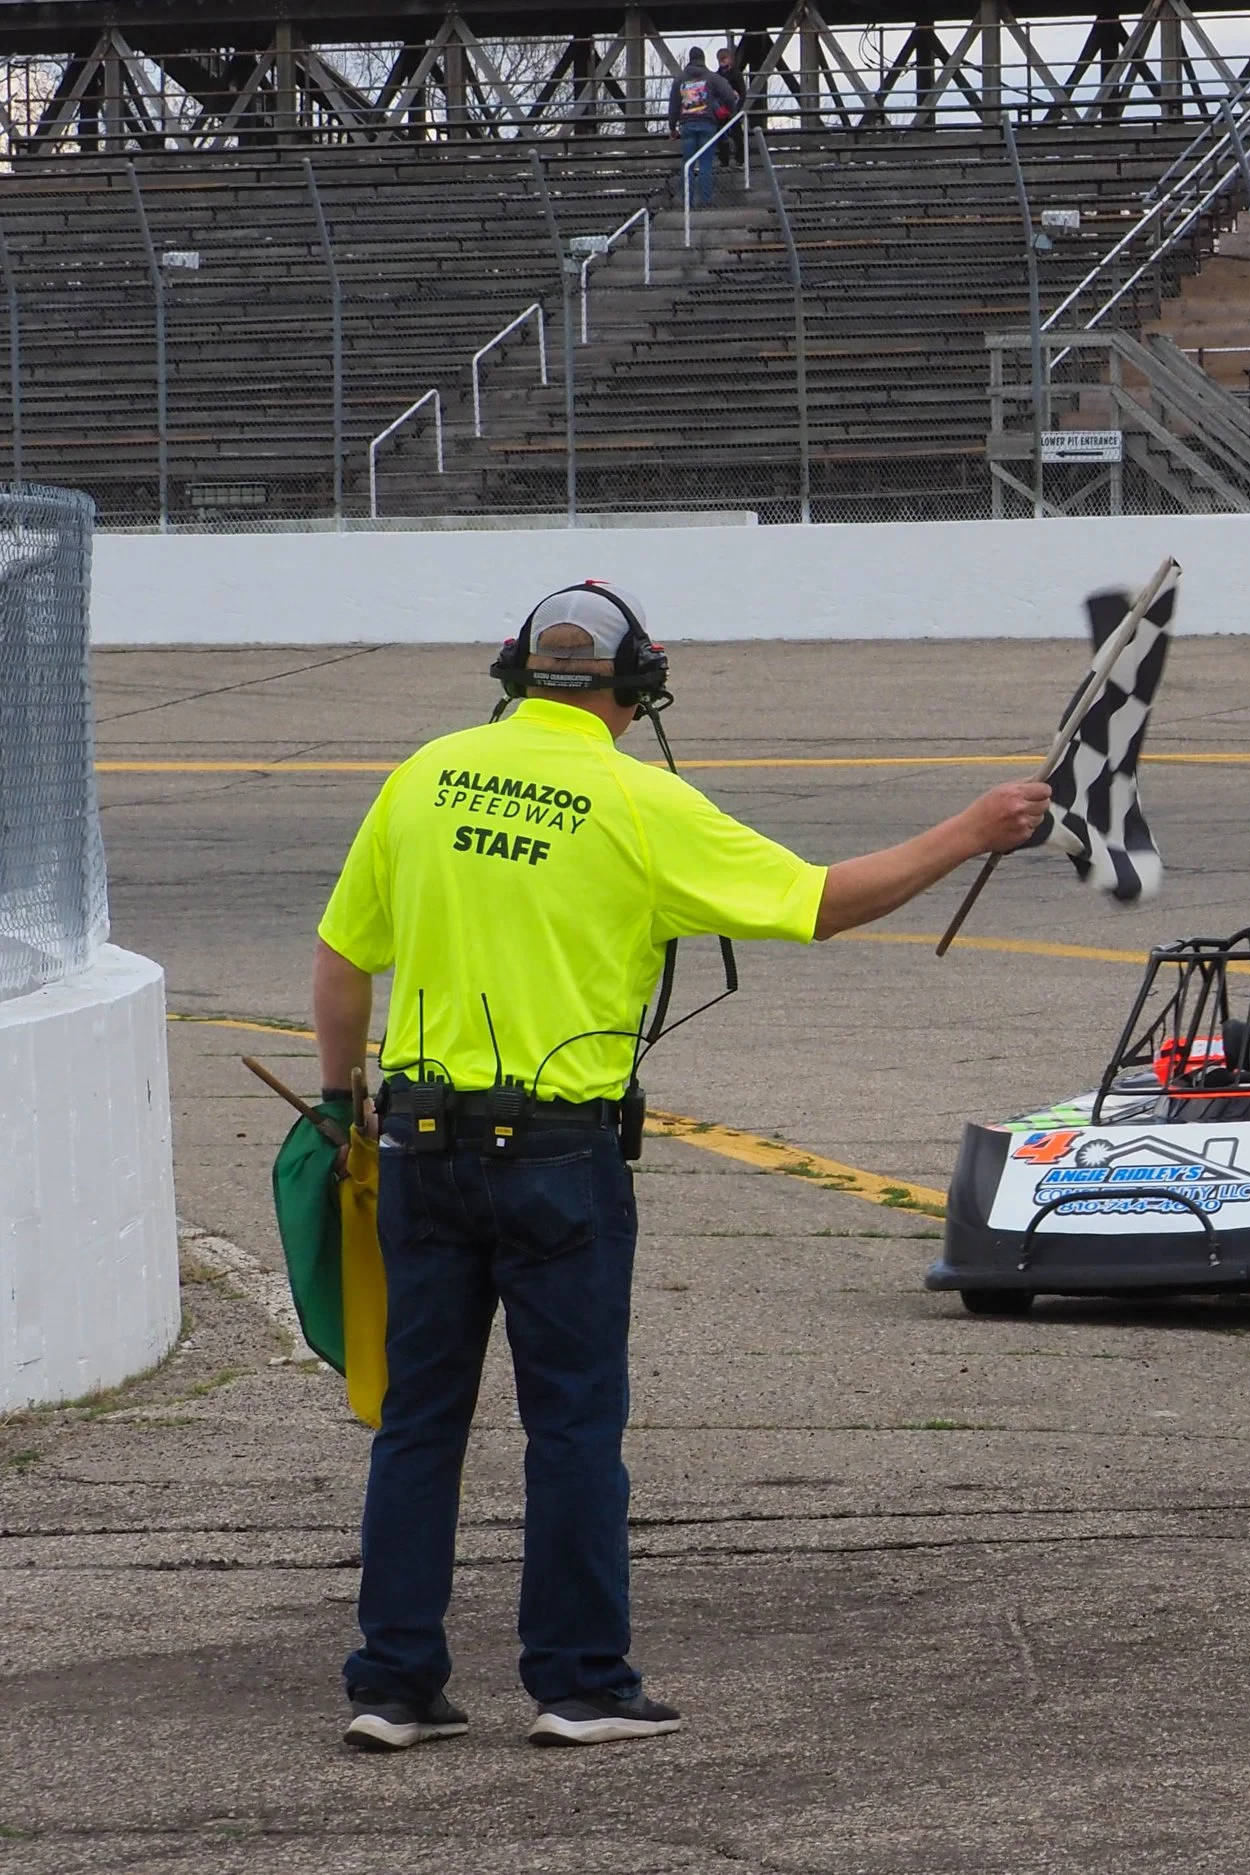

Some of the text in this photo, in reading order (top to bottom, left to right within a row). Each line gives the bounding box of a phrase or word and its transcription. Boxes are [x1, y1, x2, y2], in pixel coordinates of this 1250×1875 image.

[1041, 436, 1118, 446] LOWER PIT ENTRANCE
[438, 769, 592, 815] KALAMAZOO
[434, 788, 586, 834] SPEEDWAY
[453, 825, 551, 866] STAFF
[1012, 1131, 1084, 1165] 4
[1045, 1164, 1204, 1184] ANGIE RIDLEY'S
